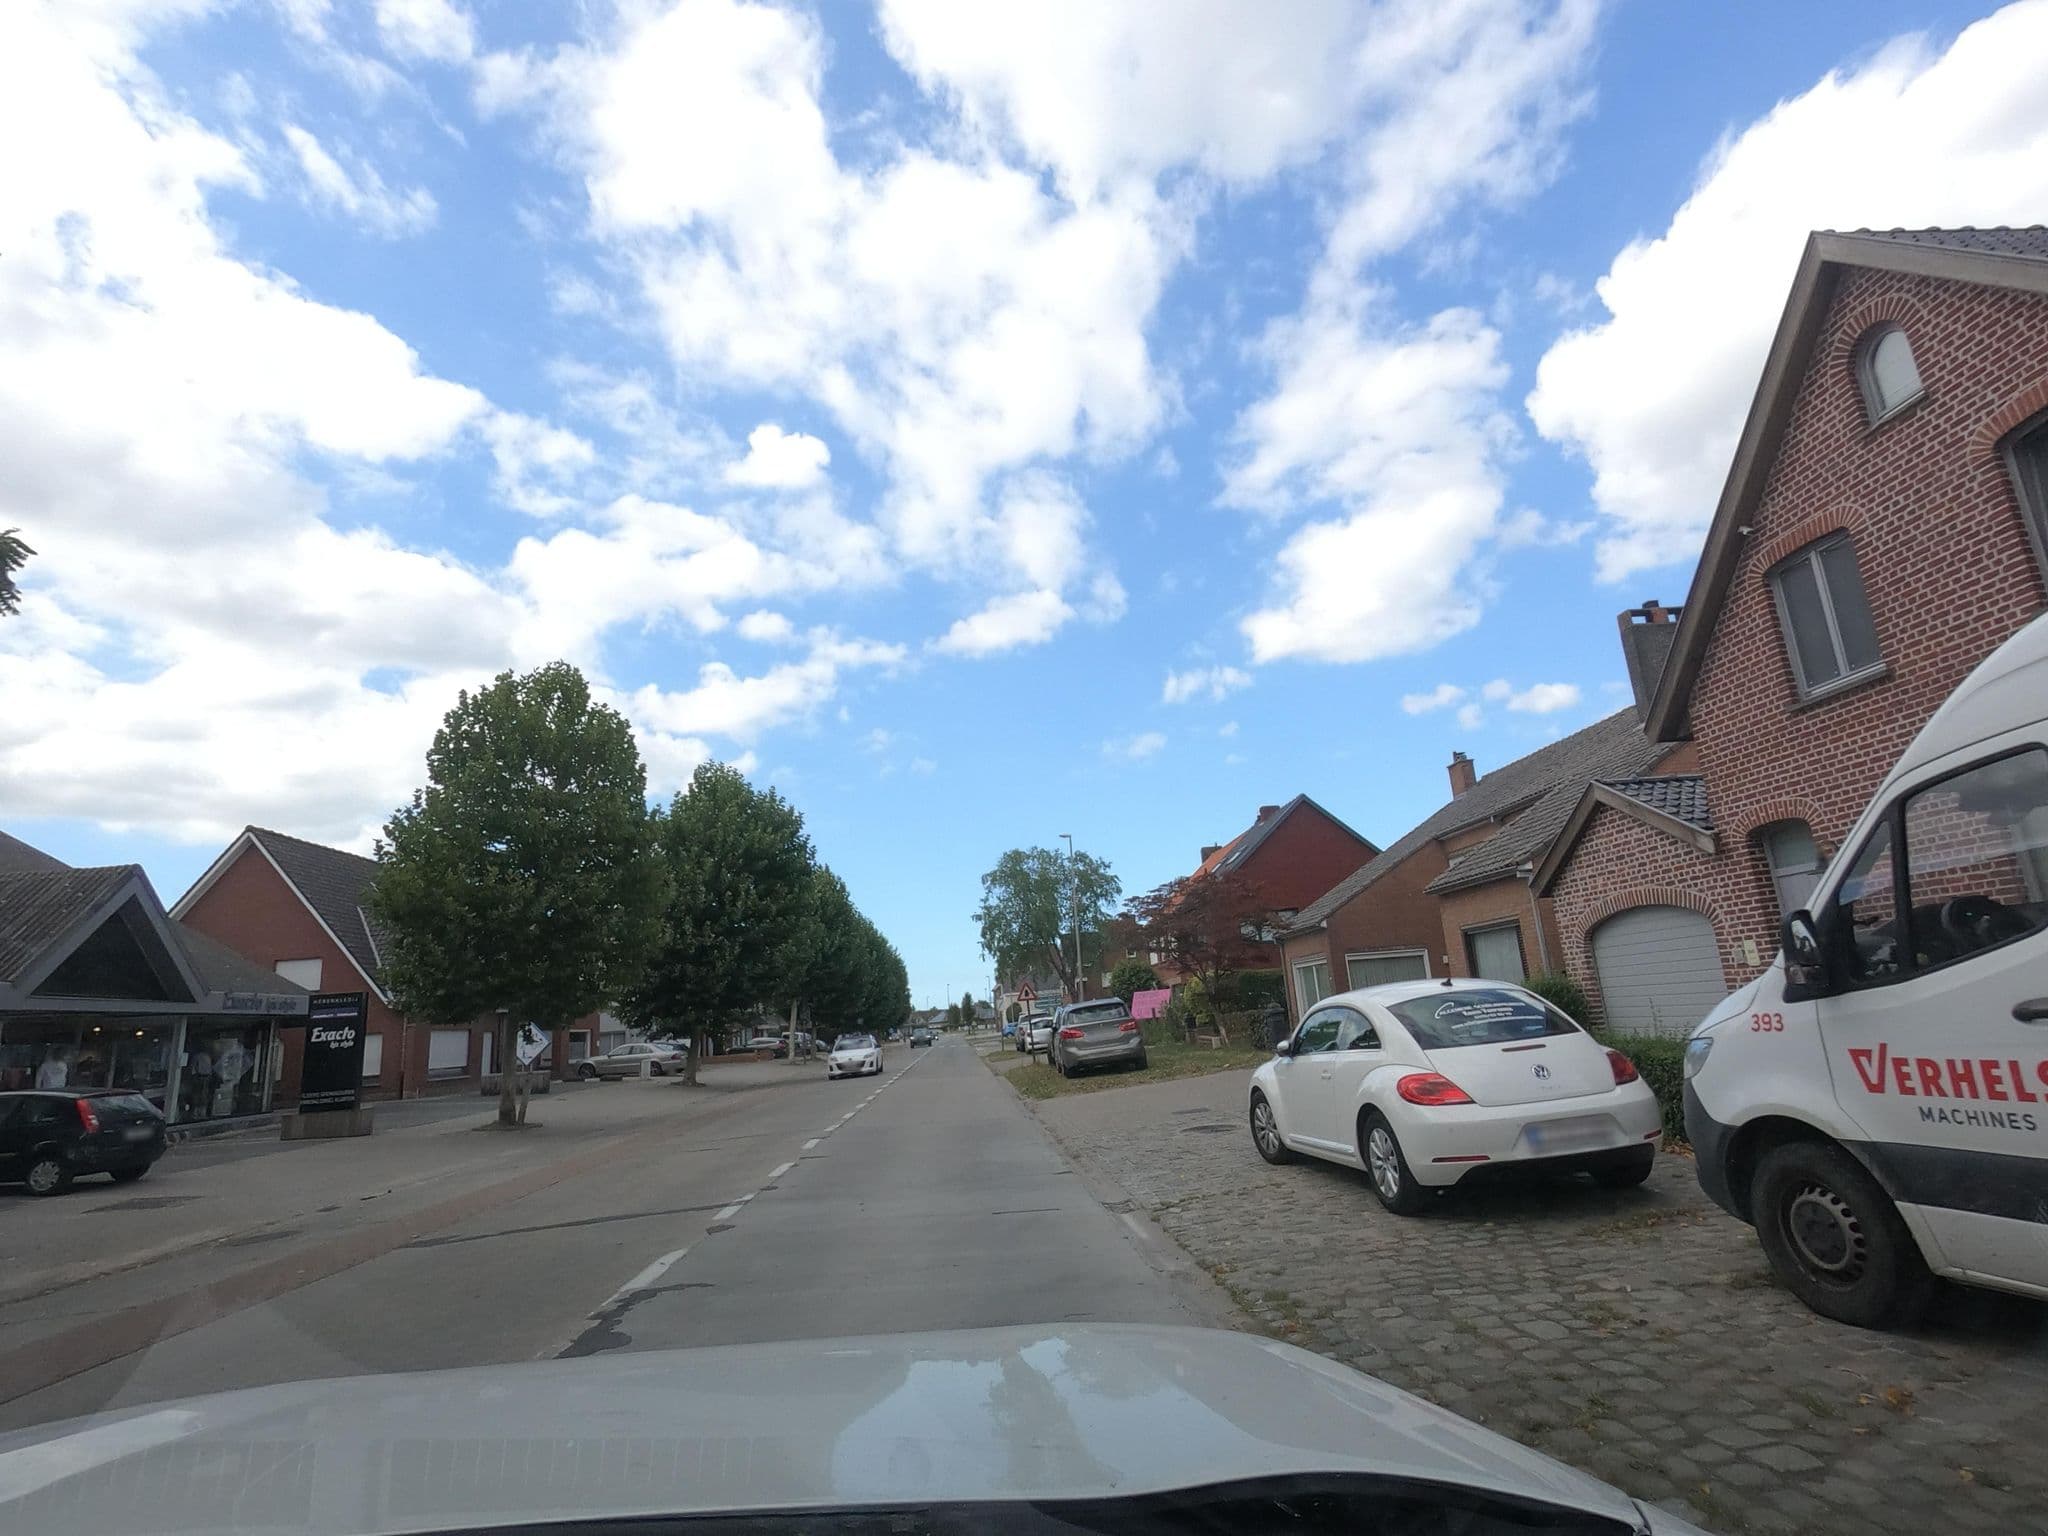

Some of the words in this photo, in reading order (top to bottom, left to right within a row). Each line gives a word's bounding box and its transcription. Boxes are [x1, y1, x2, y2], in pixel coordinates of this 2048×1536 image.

[1751, 1013, 1784, 1032] 393
[311, 1026, 356, 1042] Exacto
[1918, 1106, 2037, 1131] MACHINES
